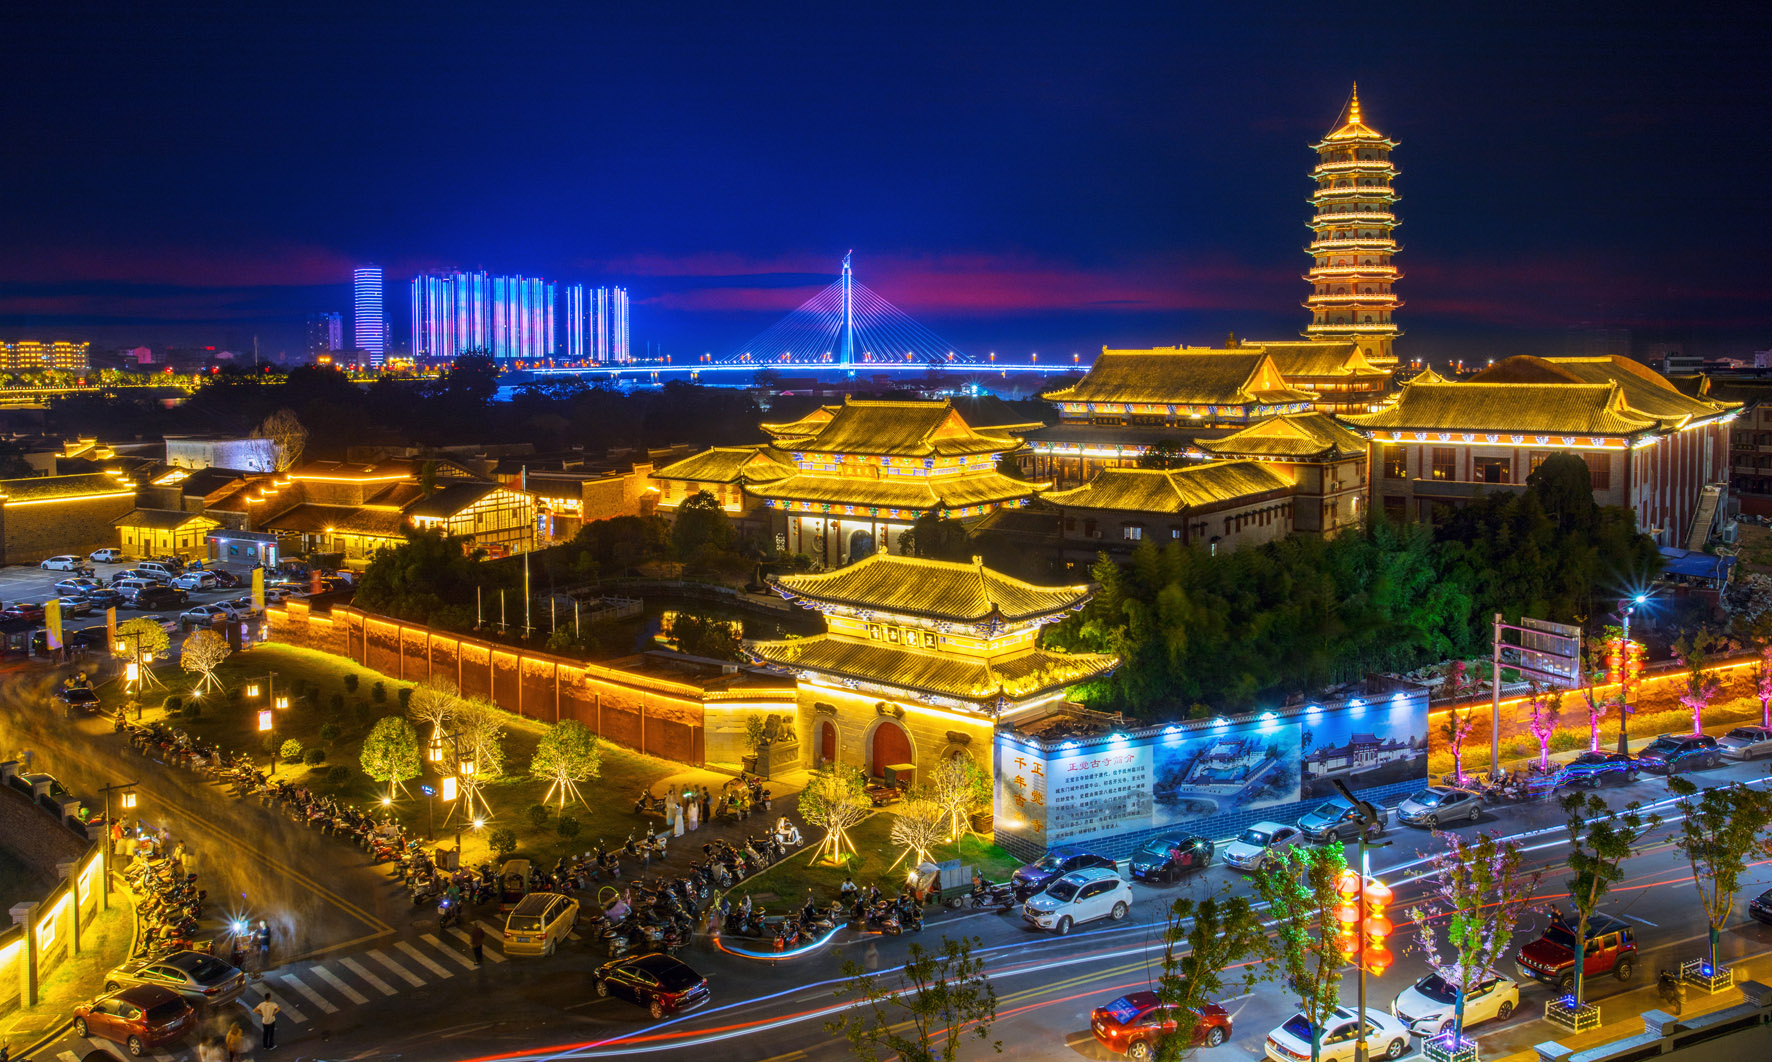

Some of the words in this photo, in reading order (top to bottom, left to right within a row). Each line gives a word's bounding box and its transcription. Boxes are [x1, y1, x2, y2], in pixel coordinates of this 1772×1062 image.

[1067, 754, 1135, 772] 正觉古寺简介
[1030, 762, 1045, 833] 正觉寺
